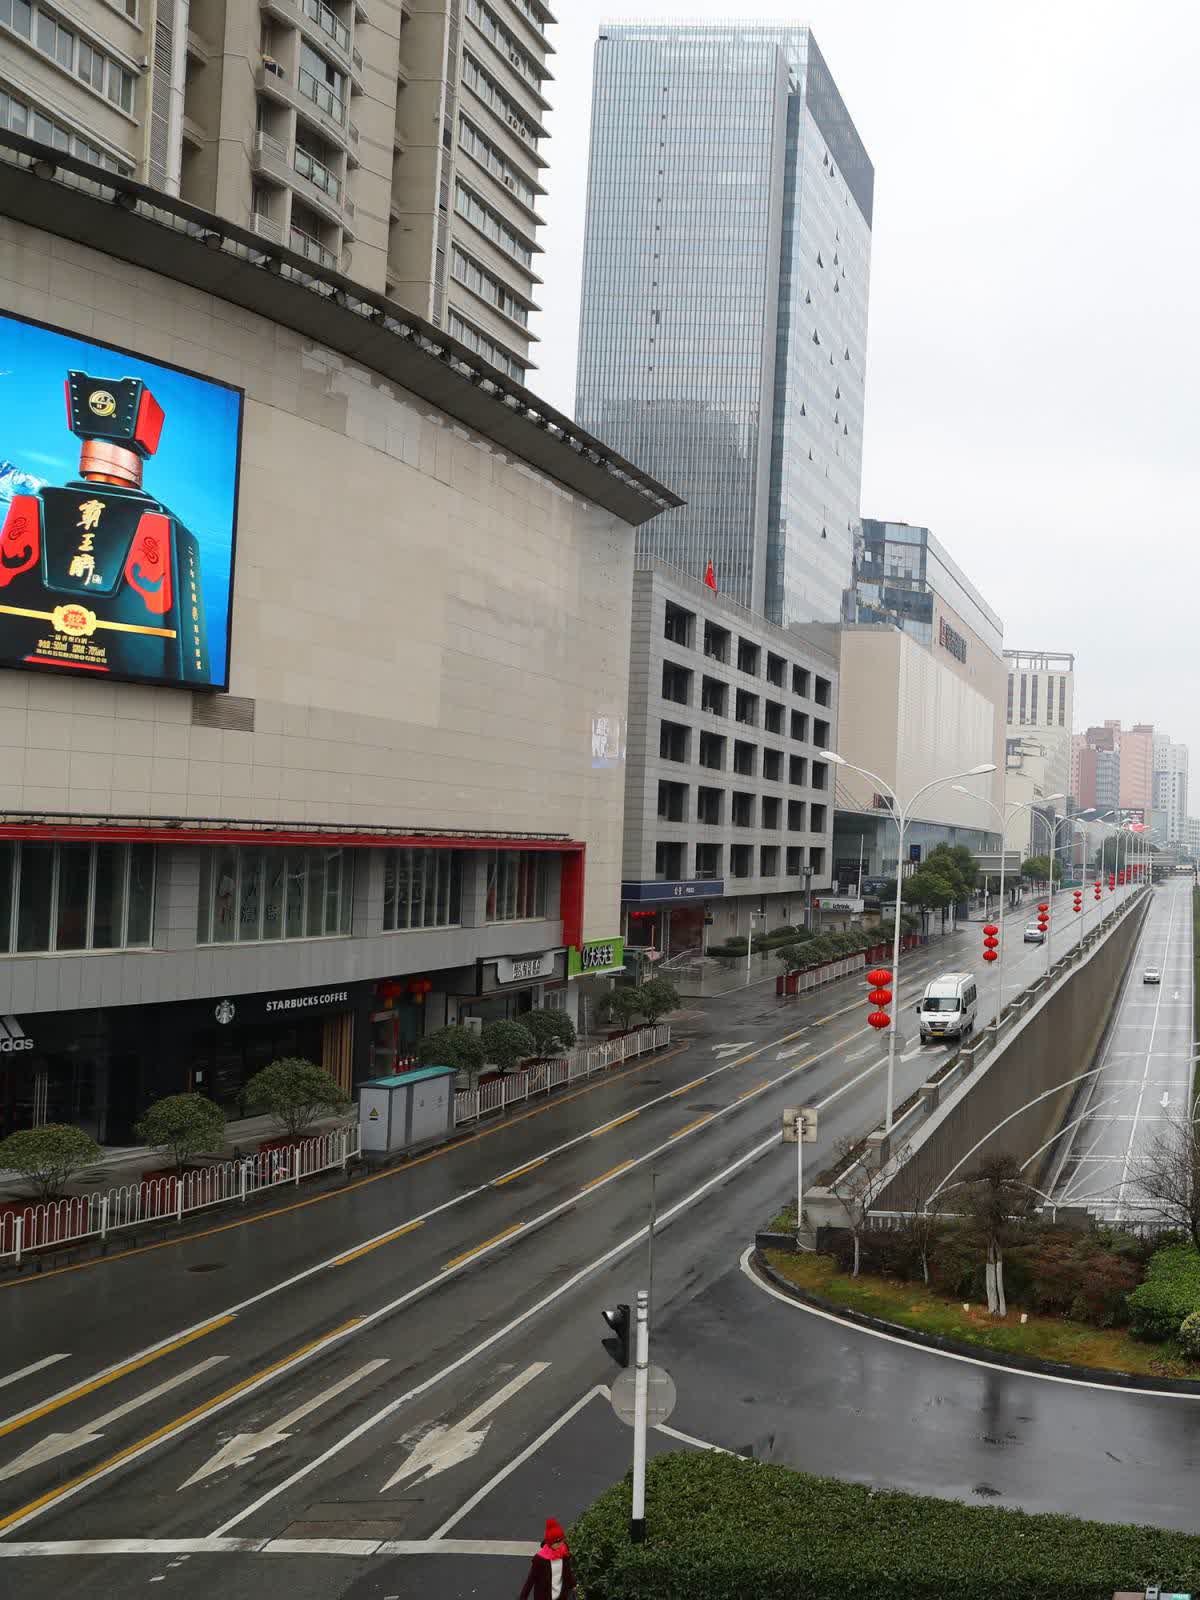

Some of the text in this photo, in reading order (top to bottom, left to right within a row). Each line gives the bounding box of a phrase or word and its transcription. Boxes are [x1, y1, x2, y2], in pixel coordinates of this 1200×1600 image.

[588, 945, 614, 967] 大米先生
[266, 991, 348, 1012] STARBUCKS COFFEE
[0, 1037, 34, 1053] das
